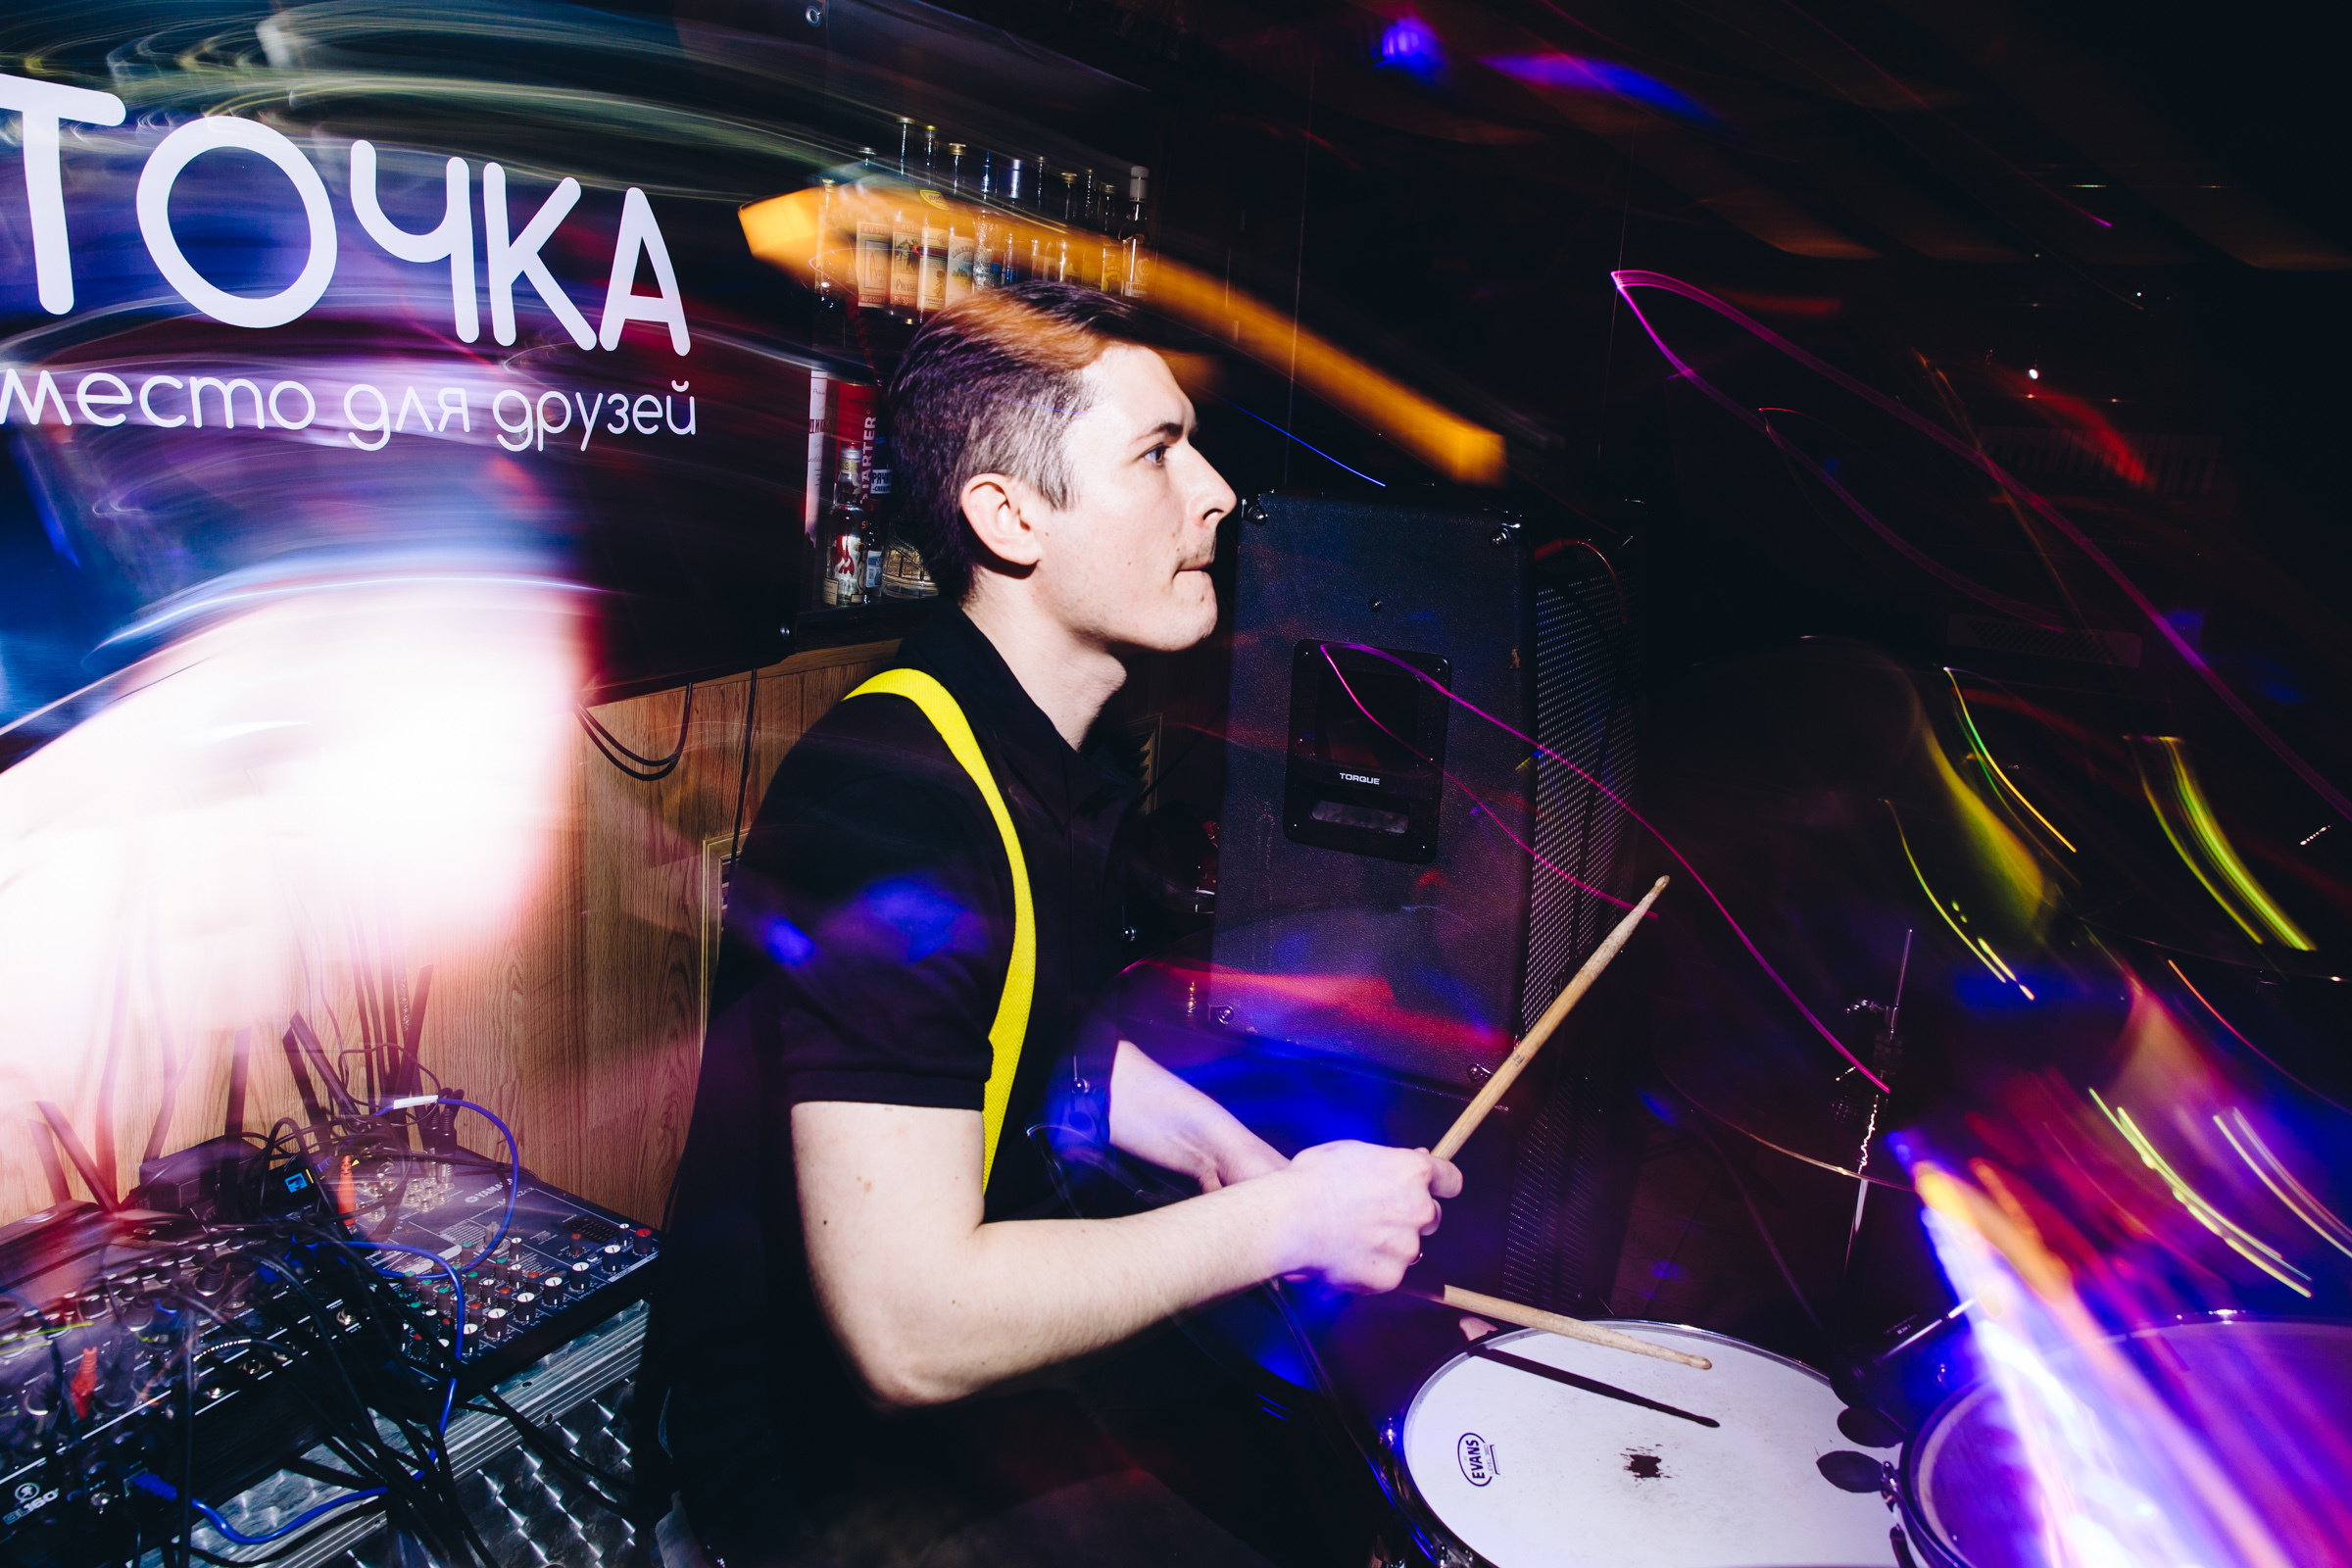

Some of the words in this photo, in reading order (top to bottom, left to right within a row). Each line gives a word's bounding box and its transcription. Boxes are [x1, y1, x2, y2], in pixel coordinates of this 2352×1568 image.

[0, 367, 317, 431] место
[344, 380, 471, 452] для
[491, 379, 697, 452] друзей
[1340, 772, 1381, 785] TORQUE
[474, 1178, 514, 1199] YAMAA
[1465, 1440, 1486, 1479] EVANS
